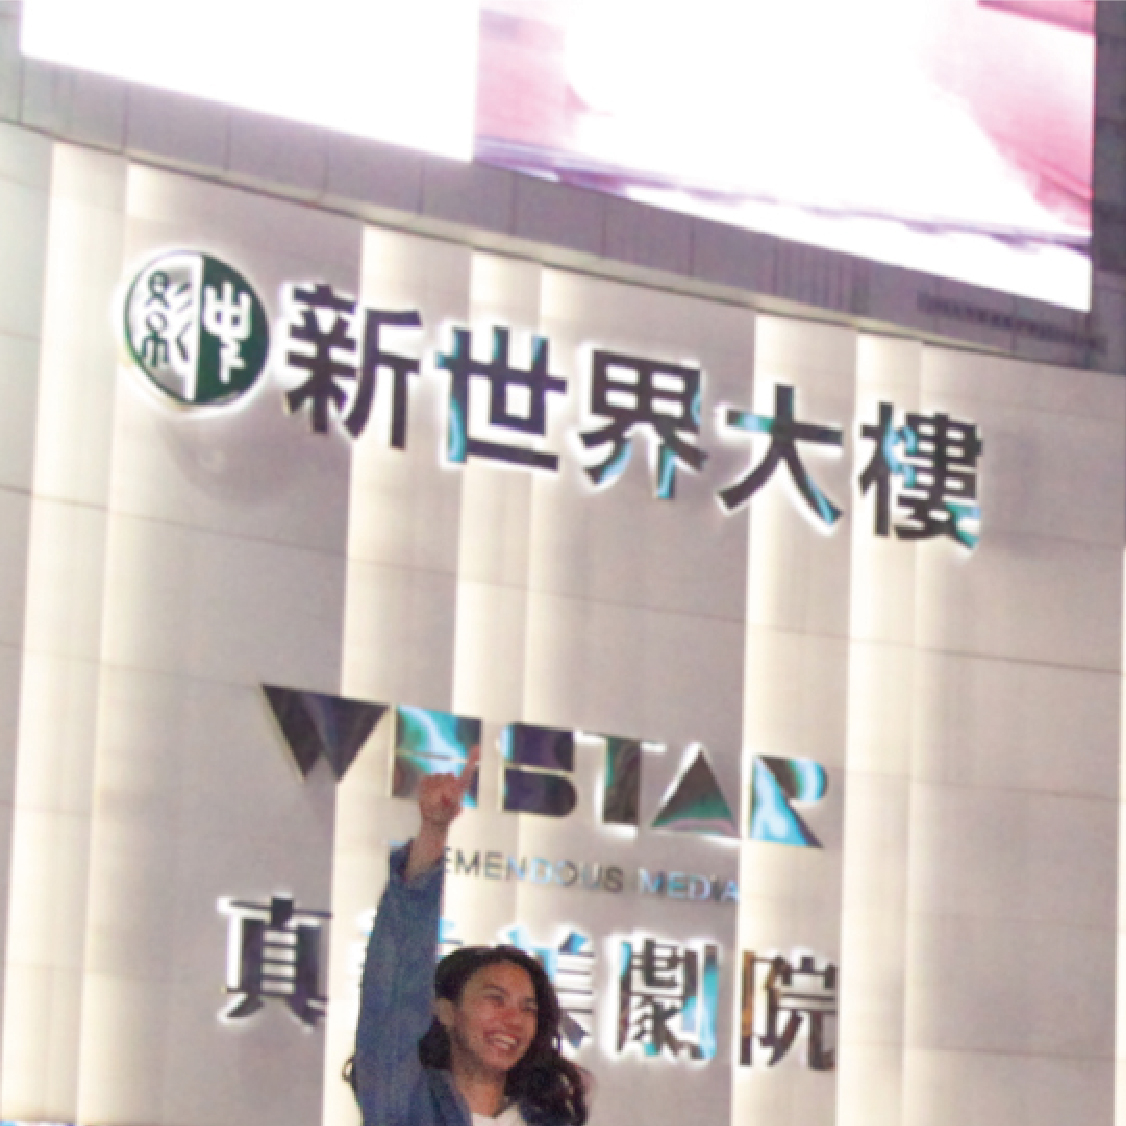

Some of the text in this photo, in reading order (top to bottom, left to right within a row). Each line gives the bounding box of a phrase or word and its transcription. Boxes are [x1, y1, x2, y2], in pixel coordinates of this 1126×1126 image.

[284, 281, 984, 549] 新世界大樓
[638, 866, 740, 903] MEDIA
